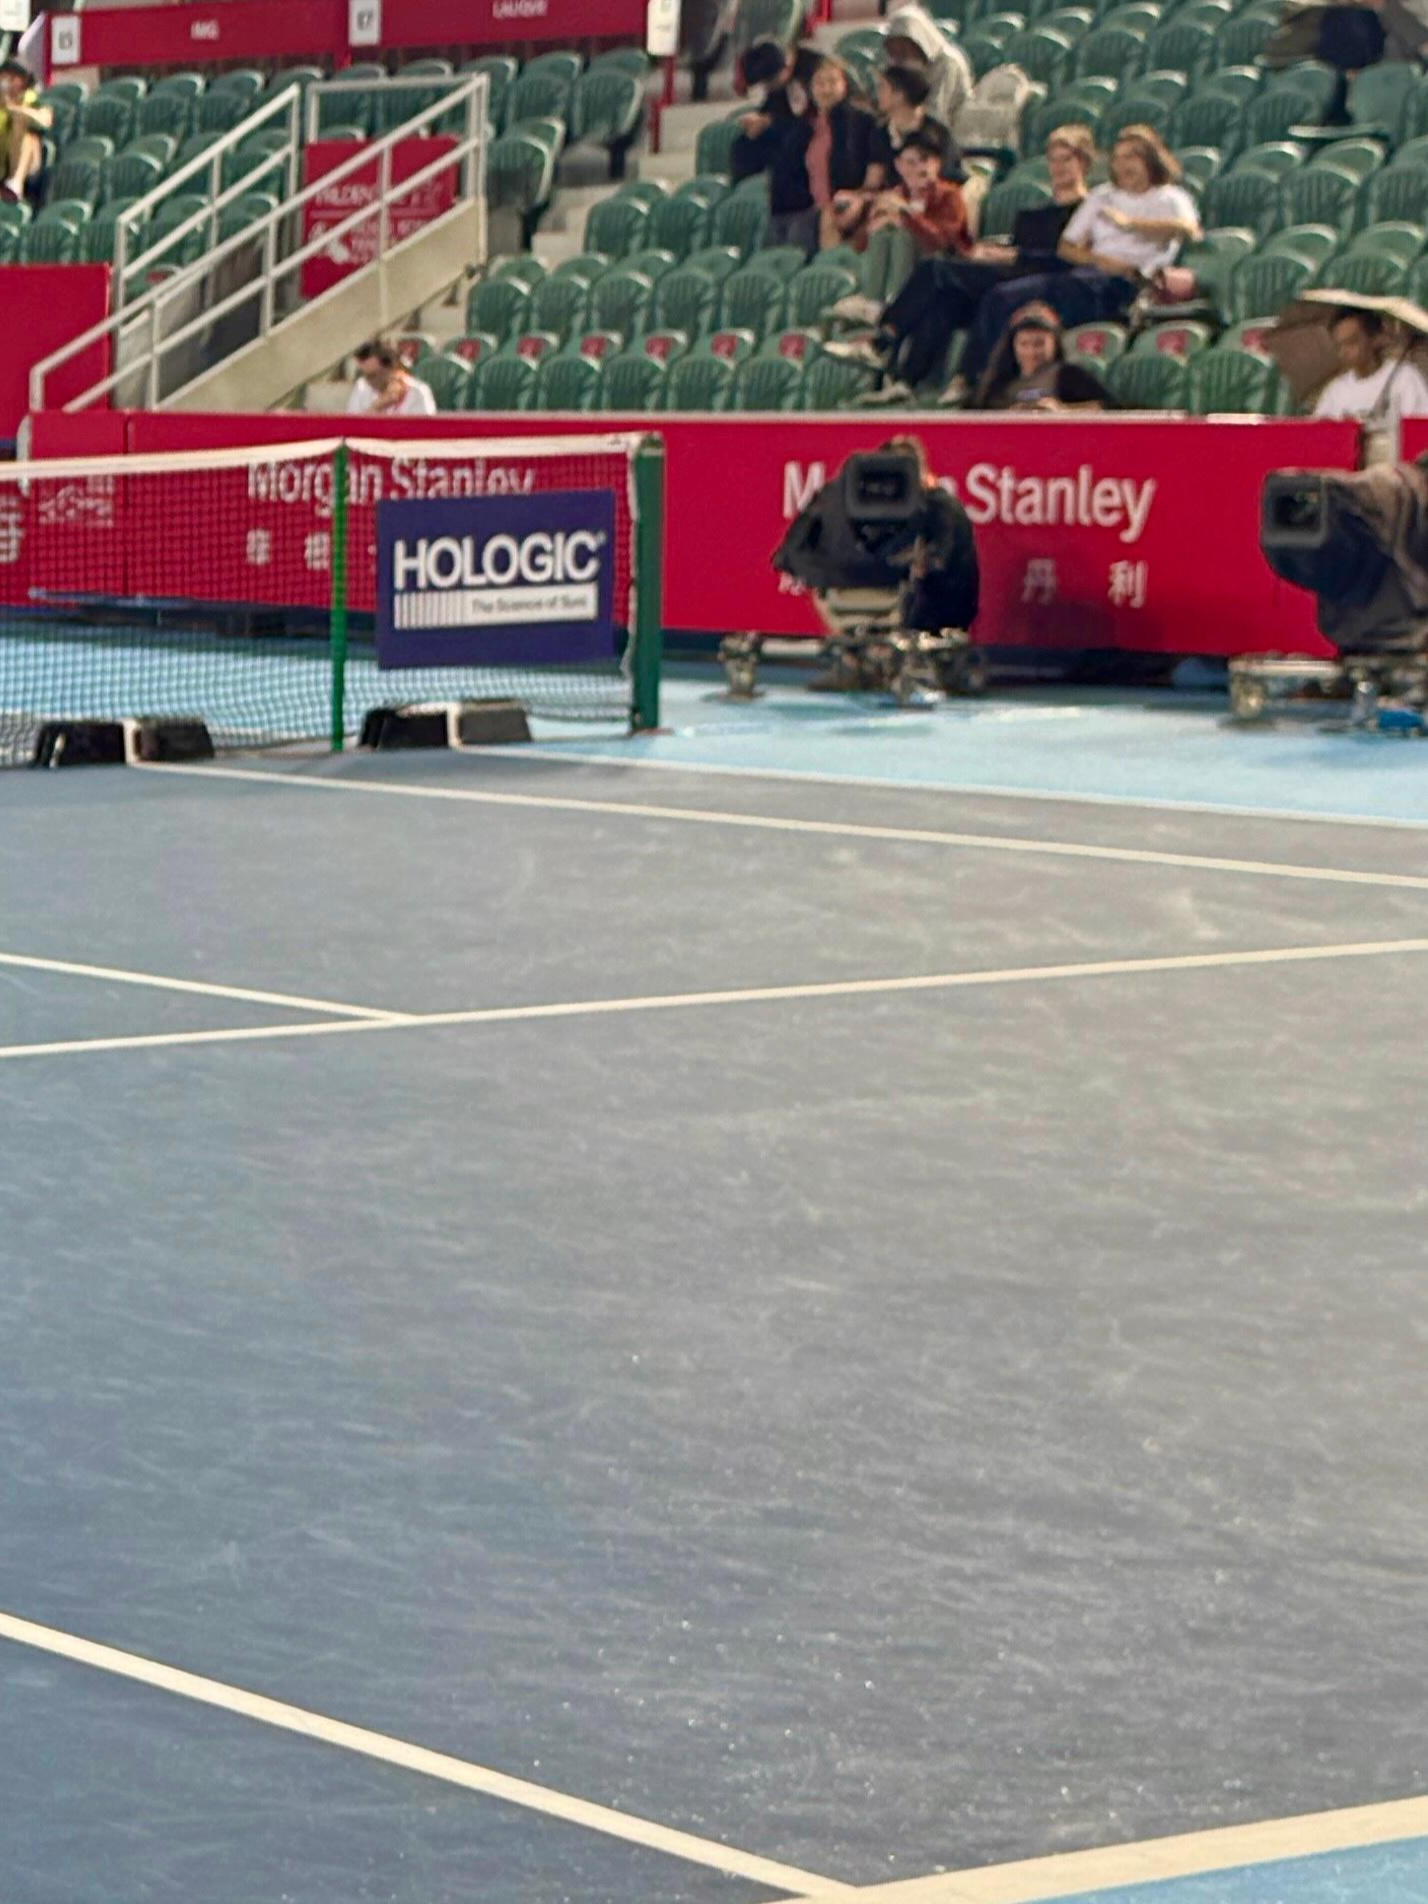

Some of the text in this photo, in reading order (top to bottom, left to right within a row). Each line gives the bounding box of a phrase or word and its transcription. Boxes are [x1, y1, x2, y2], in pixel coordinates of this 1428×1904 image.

[246, 457, 539, 516] Morgan Stanley
[964, 462, 1156, 543] Stanley
[392, 530, 603, 591] HOLOGIC
